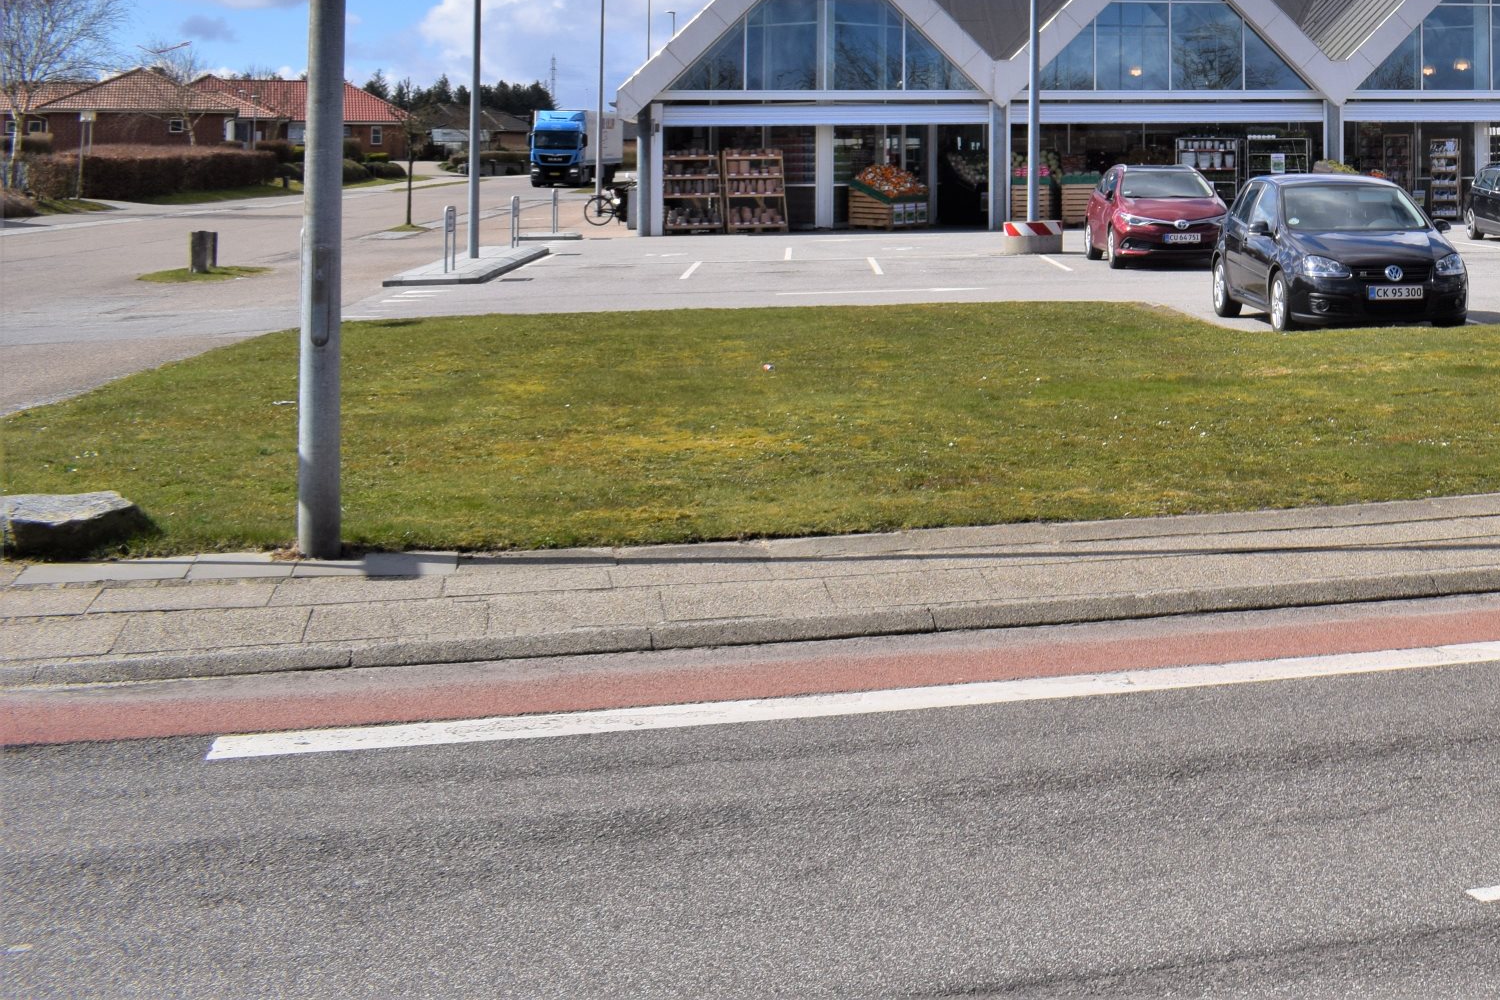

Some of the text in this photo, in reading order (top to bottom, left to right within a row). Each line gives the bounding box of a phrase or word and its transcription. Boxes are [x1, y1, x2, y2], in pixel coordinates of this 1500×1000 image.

[1376, 287, 1422, 298] CK 95 300
